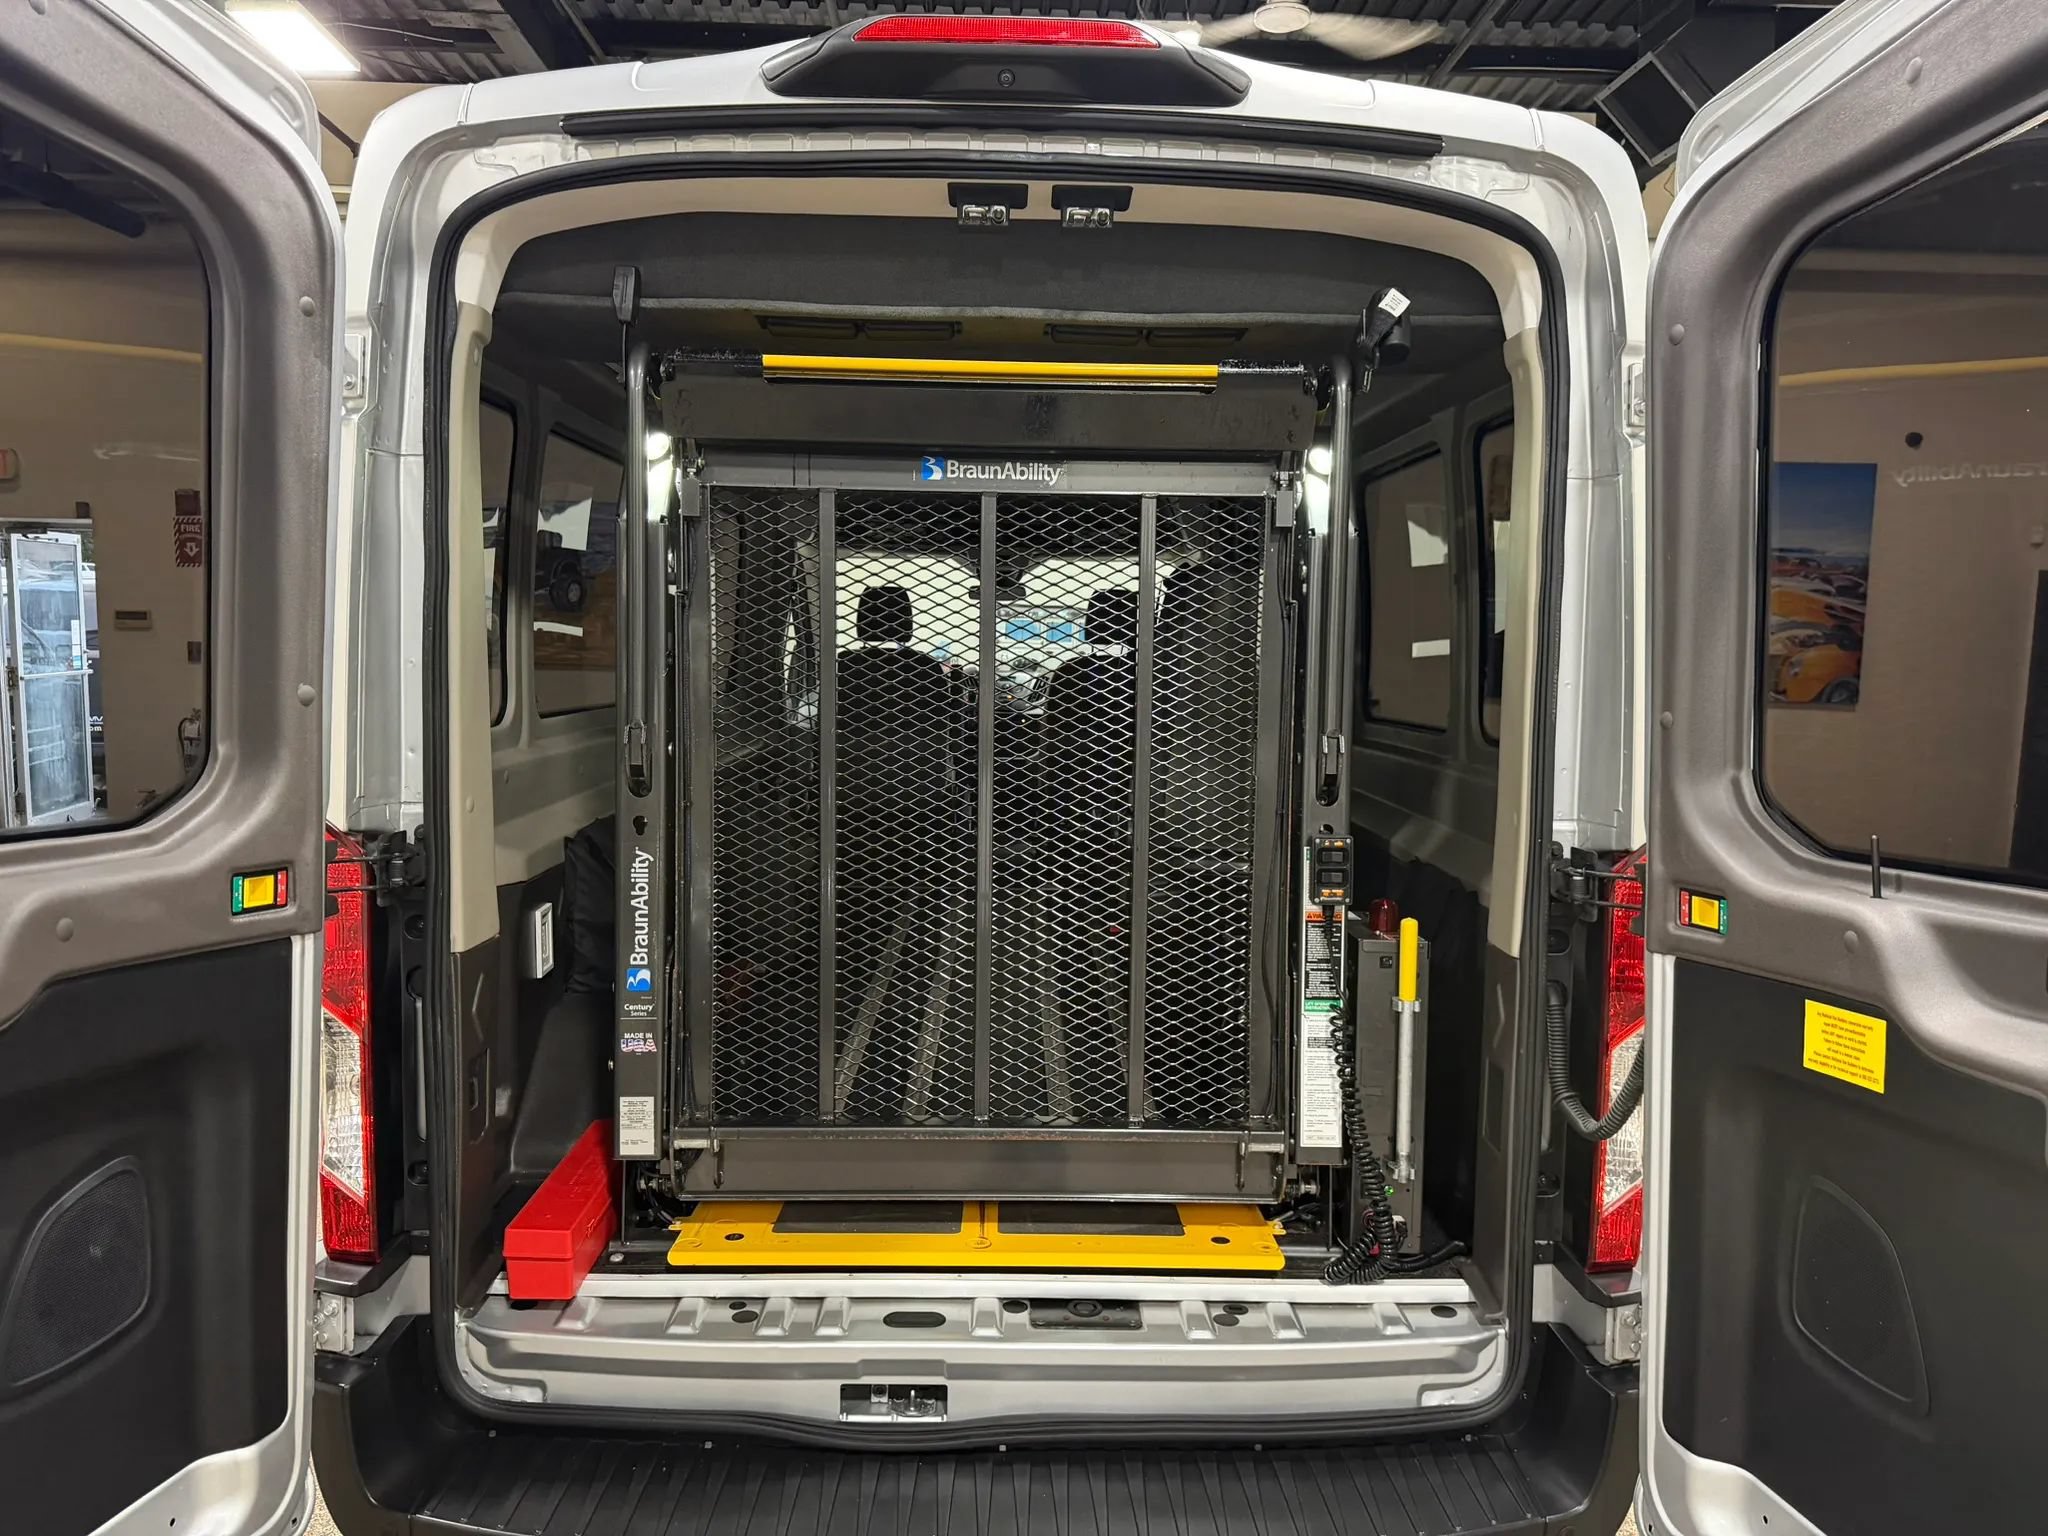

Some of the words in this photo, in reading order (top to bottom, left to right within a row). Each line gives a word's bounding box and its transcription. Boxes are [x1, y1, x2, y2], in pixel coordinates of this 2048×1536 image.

[946, 459, 1061, 486] BraunAbility
[181, 524, 200, 533] FIRE
[630, 848, 654, 966] BraunAbility
[624, 1003, 653, 1012] Century
[620, 1039, 657, 1052] USA
